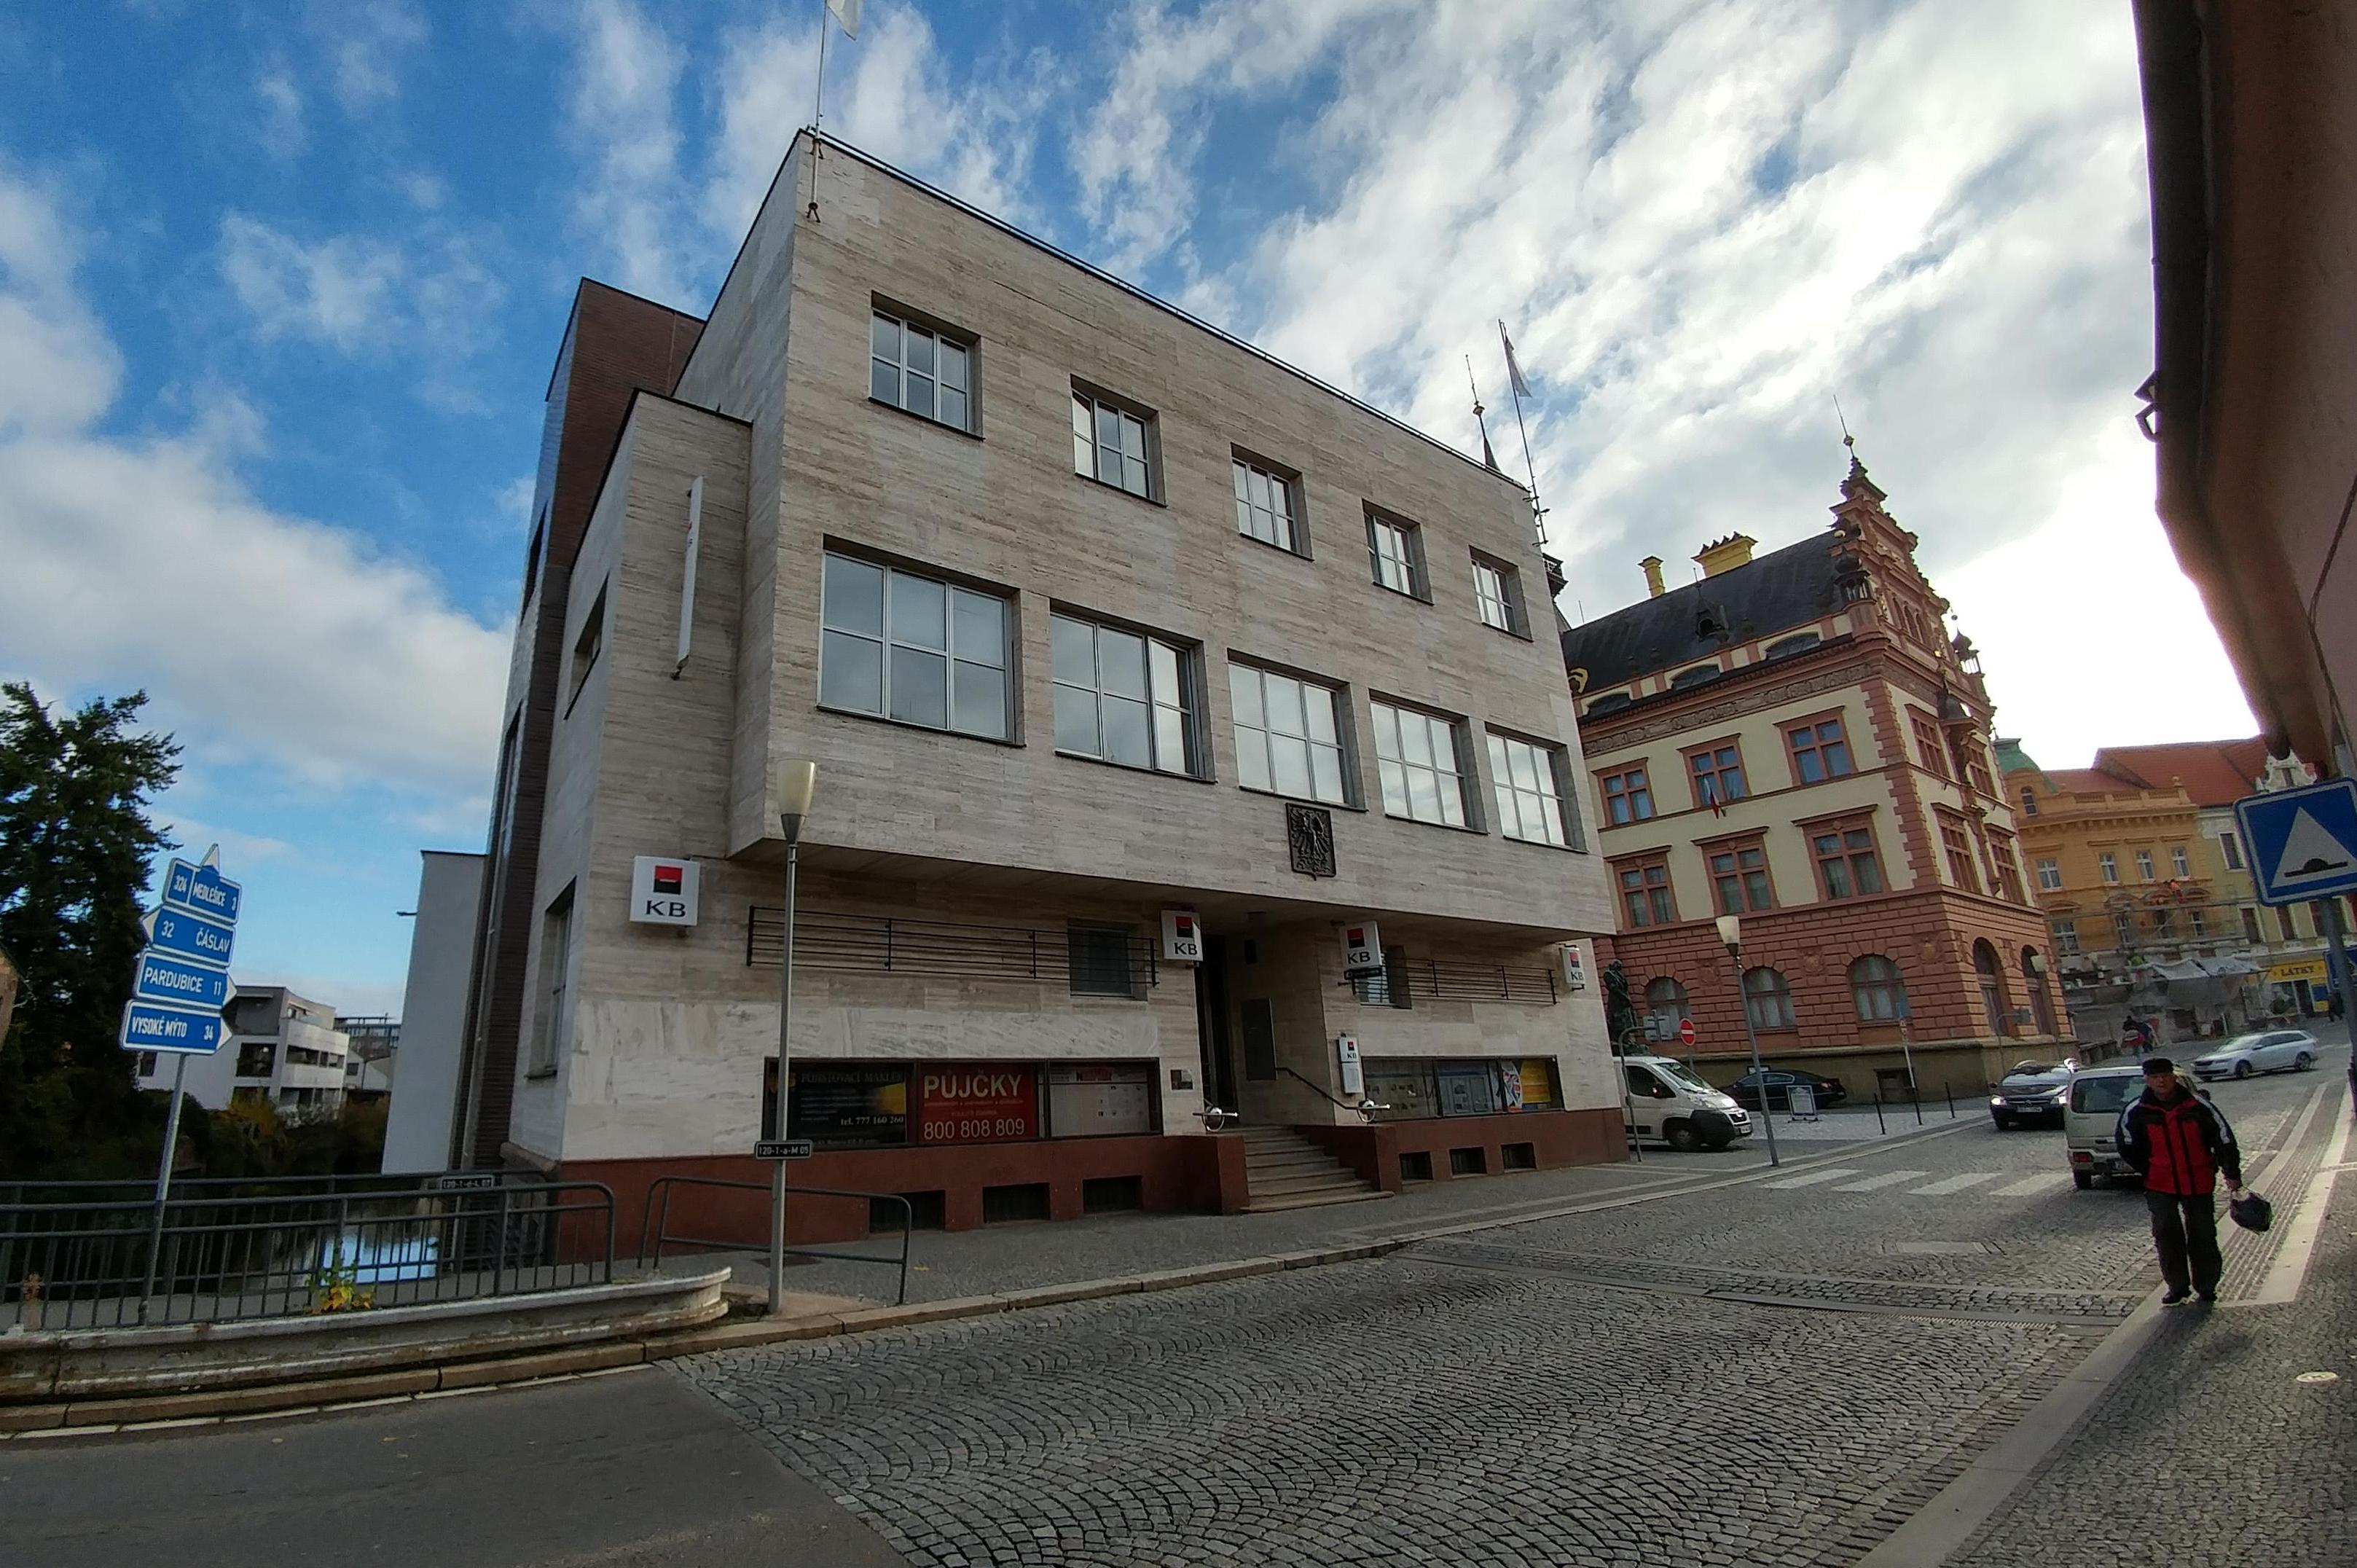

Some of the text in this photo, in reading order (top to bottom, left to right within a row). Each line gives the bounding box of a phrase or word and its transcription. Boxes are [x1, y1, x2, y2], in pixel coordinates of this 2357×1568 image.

[173, 875, 238, 911] 324 MEDLEŠICE 3
[646, 900, 686, 917] KB
[161, 920, 231, 953] 32 ČÁSLAV
[1174, 942, 1197, 955] KB
[1347, 951, 1370, 964] KB
[144, 967, 222, 996] PARDUBICE 11
[1570, 971, 1583, 981] KB
[132, 1016, 214, 1041] VYSOKÉ MÝTO 34
[924, 1068, 1021, 1099] PŮJČKY
[841, 1116, 904, 1126] tel. 777 160 260
[924, 1118, 1024, 1140] 800 808 809
